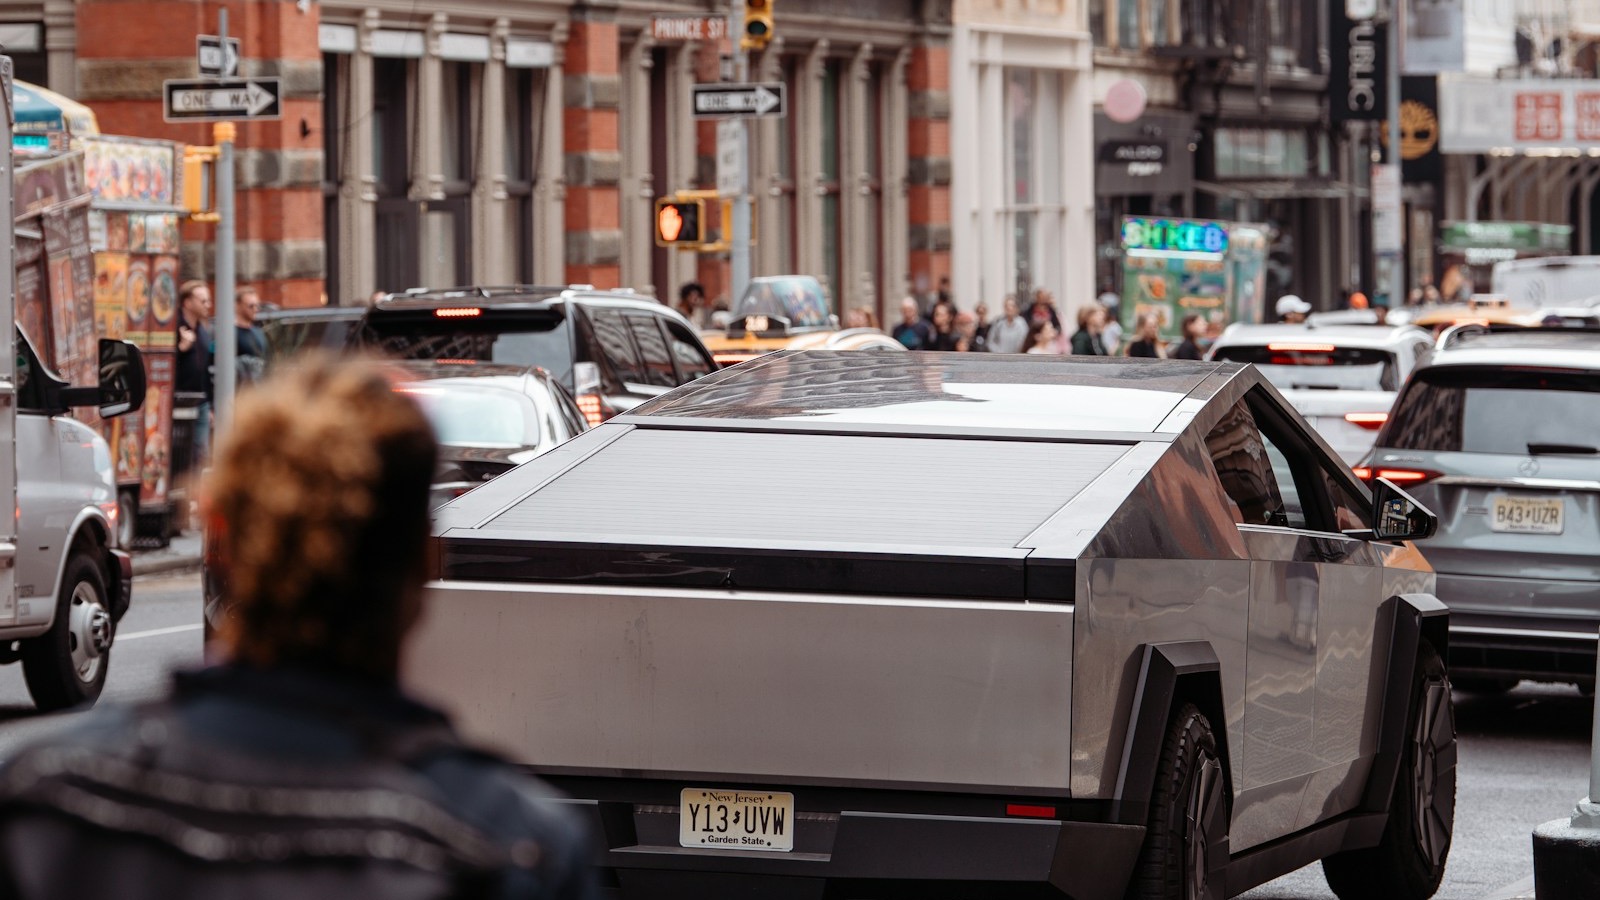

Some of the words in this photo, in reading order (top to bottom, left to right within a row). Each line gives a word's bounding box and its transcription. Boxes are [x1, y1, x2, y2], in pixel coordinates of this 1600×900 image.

[656, 18, 702, 39] PRINCE
[708, 18, 724, 39] ST
[1347, 21, 1376, 112] UBLIC
[181, 90, 213, 110] ONE
[229, 91, 261, 107] WAY
[703, 93, 729, 108] ONE
[1115, 145, 1163, 160] ALDO
[708, 792, 733, 802] New
[733, 793, 765, 806] Jersey
[708, 834, 739, 844] Garden
[741, 836, 765, 845] State
